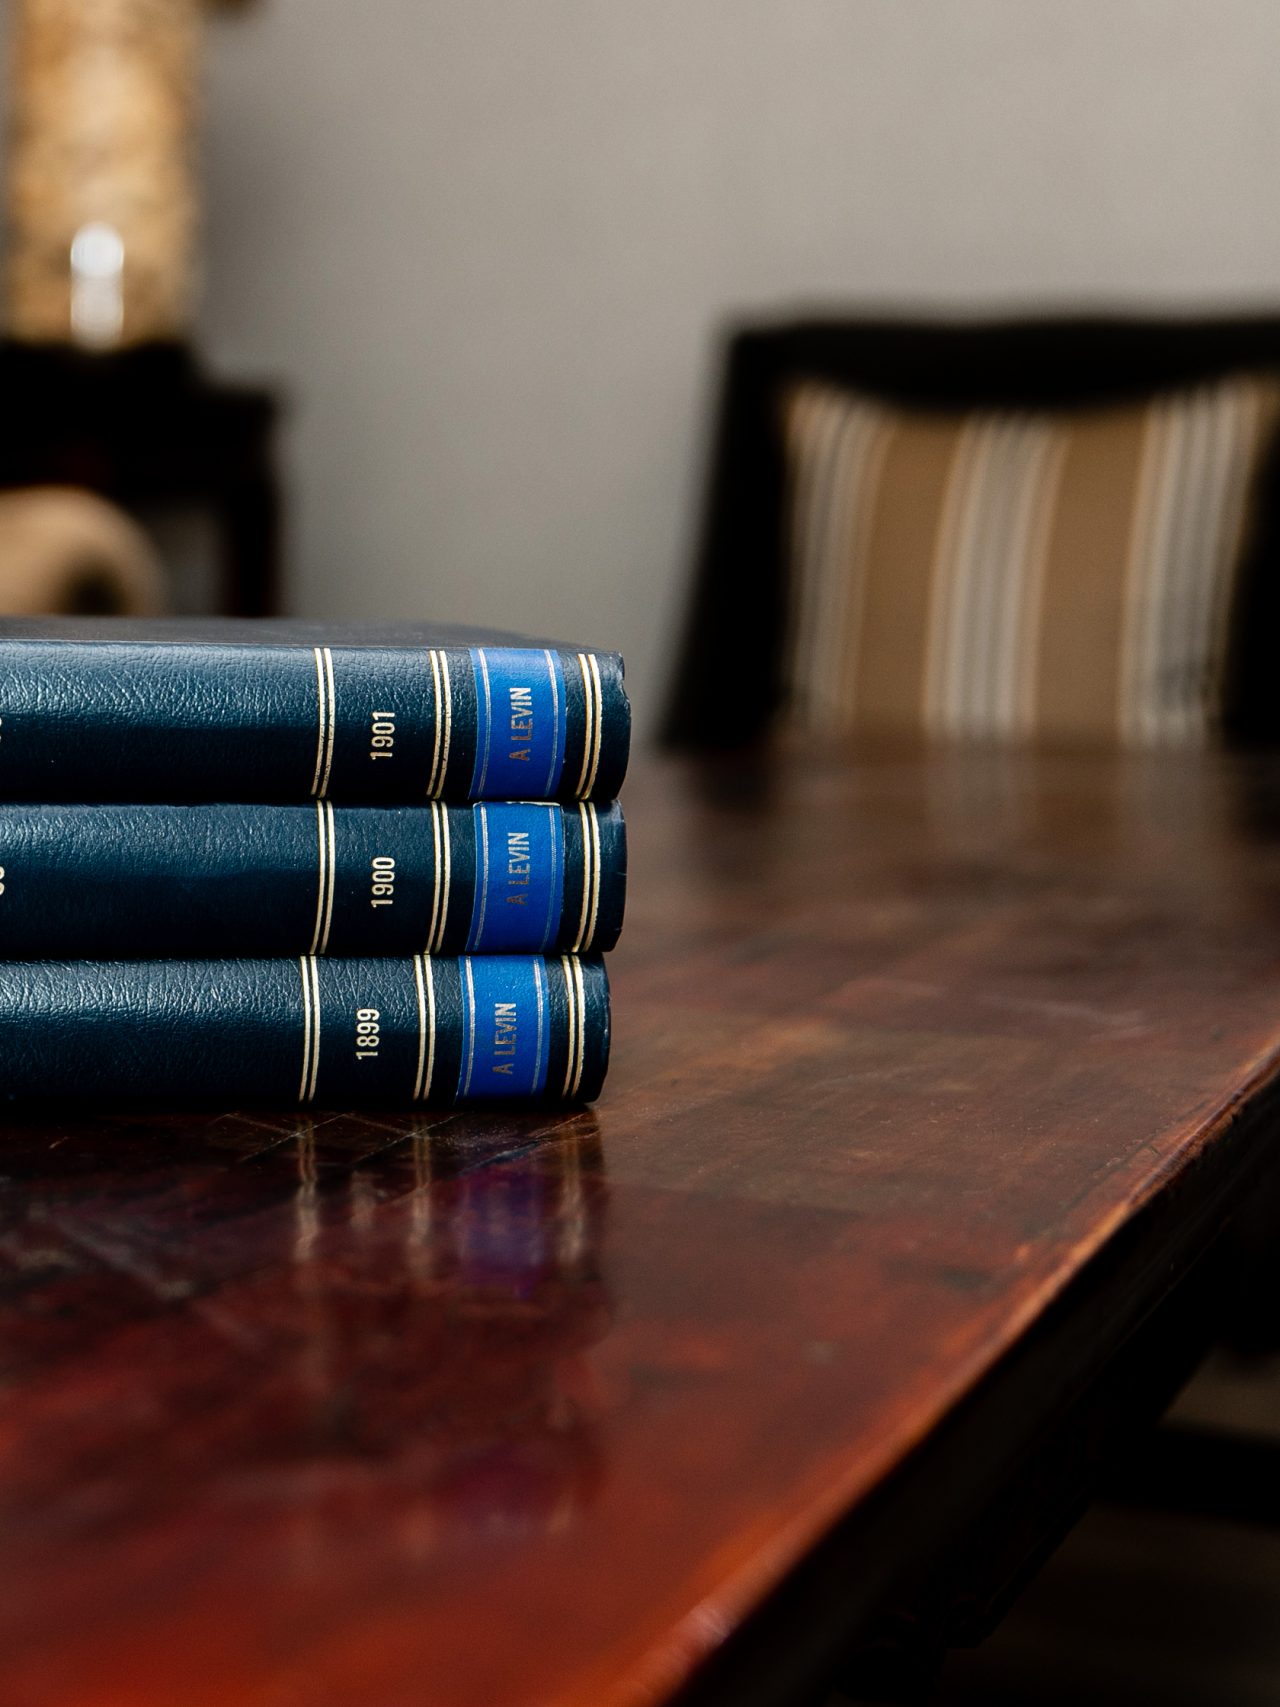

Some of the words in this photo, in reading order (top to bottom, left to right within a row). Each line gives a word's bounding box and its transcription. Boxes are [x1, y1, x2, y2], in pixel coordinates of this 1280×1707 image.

[370, 711, 396, 760] 1901
[510, 687, 532, 740] LEVIN
[509, 746, 530, 761] A
[371, 856, 395, 908] 1900
[508, 832, 529, 885] LEVIN
[507, 890, 528, 906] A
[356, 1008, 380, 1060] 1899
[494, 1003, 516, 1056] LEVIN
[492, 1060, 513, 1075] A
